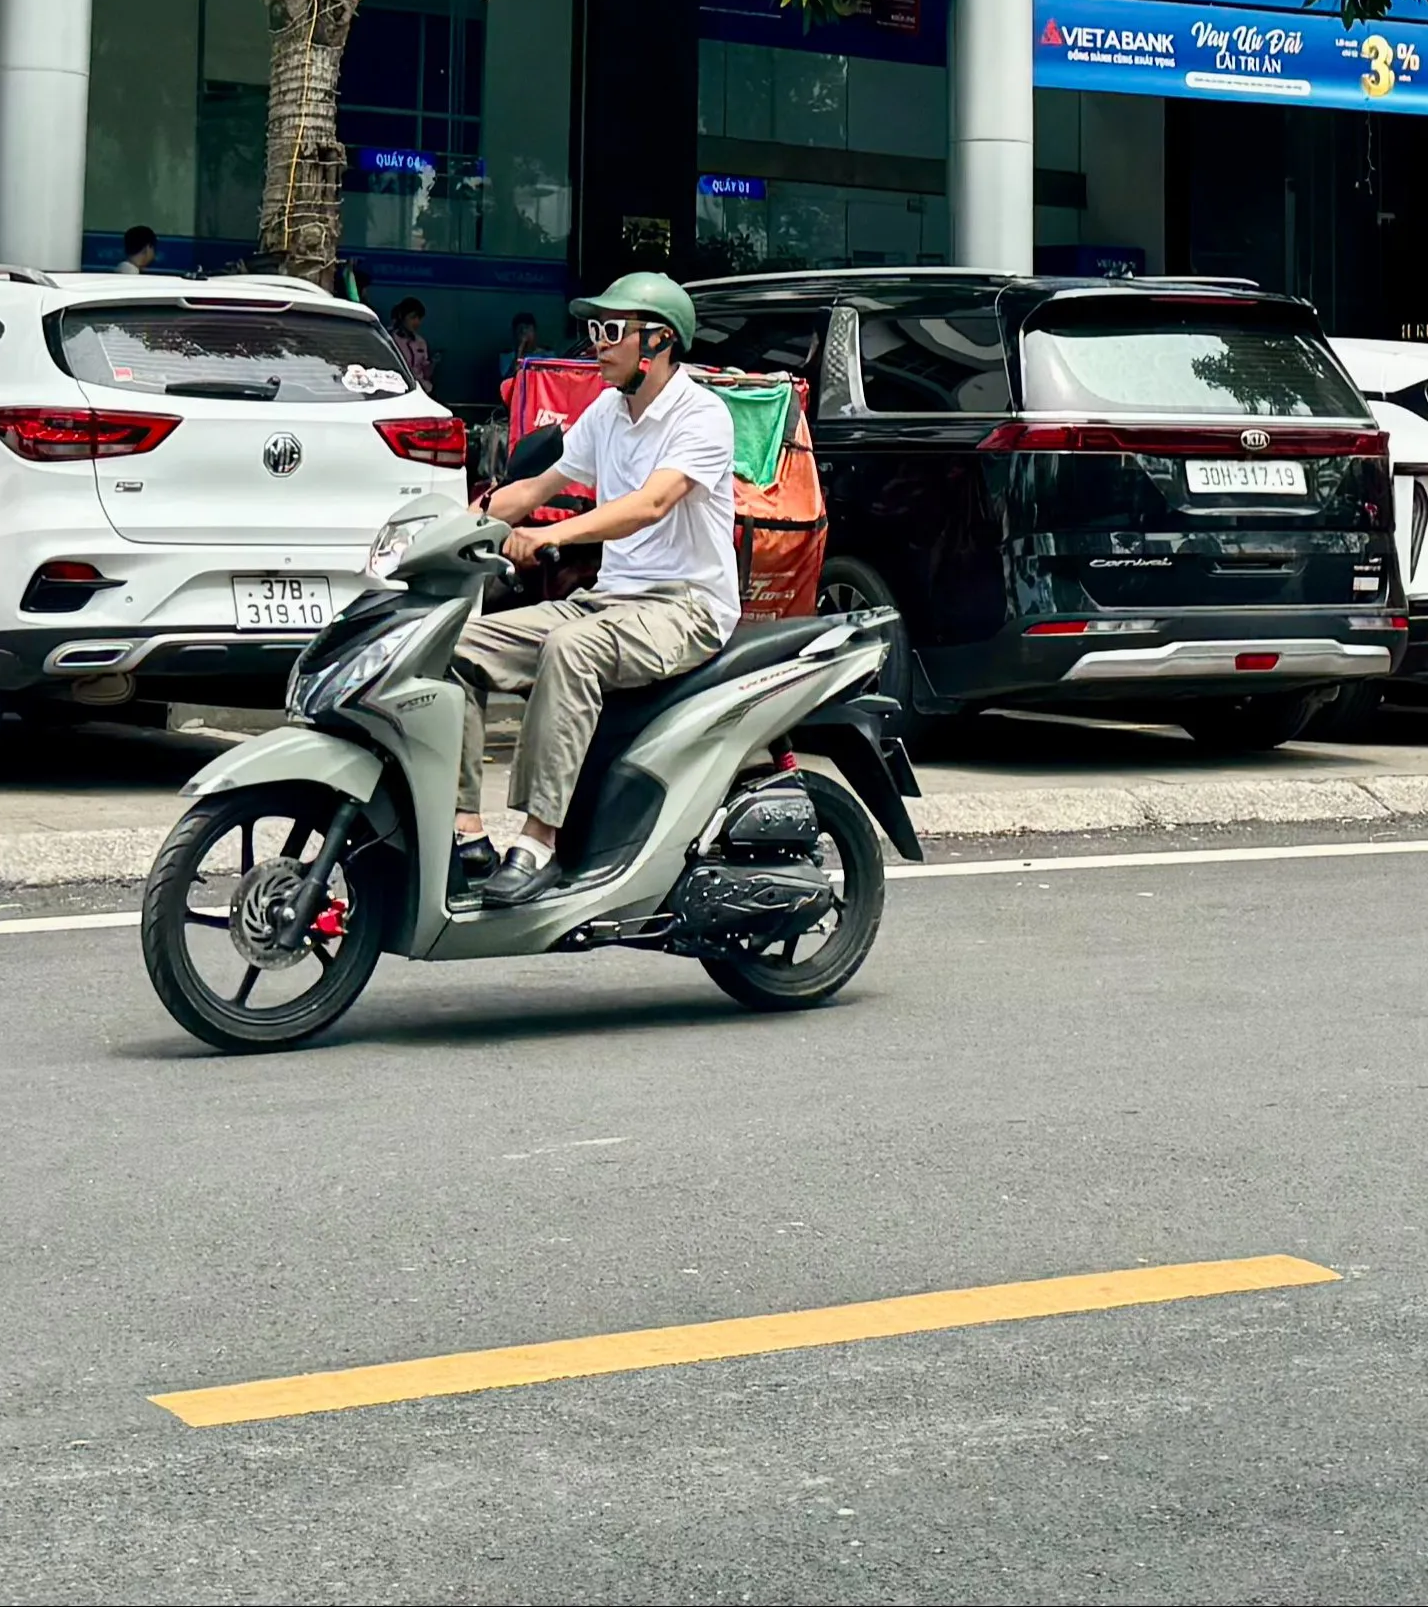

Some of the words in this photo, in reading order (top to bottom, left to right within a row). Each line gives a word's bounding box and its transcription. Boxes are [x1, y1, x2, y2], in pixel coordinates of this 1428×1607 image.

[1191, 21, 1230, 55] Vay
[1245, 434, 1267, 445] KIA
[247, 603, 324, 625] 319.10
